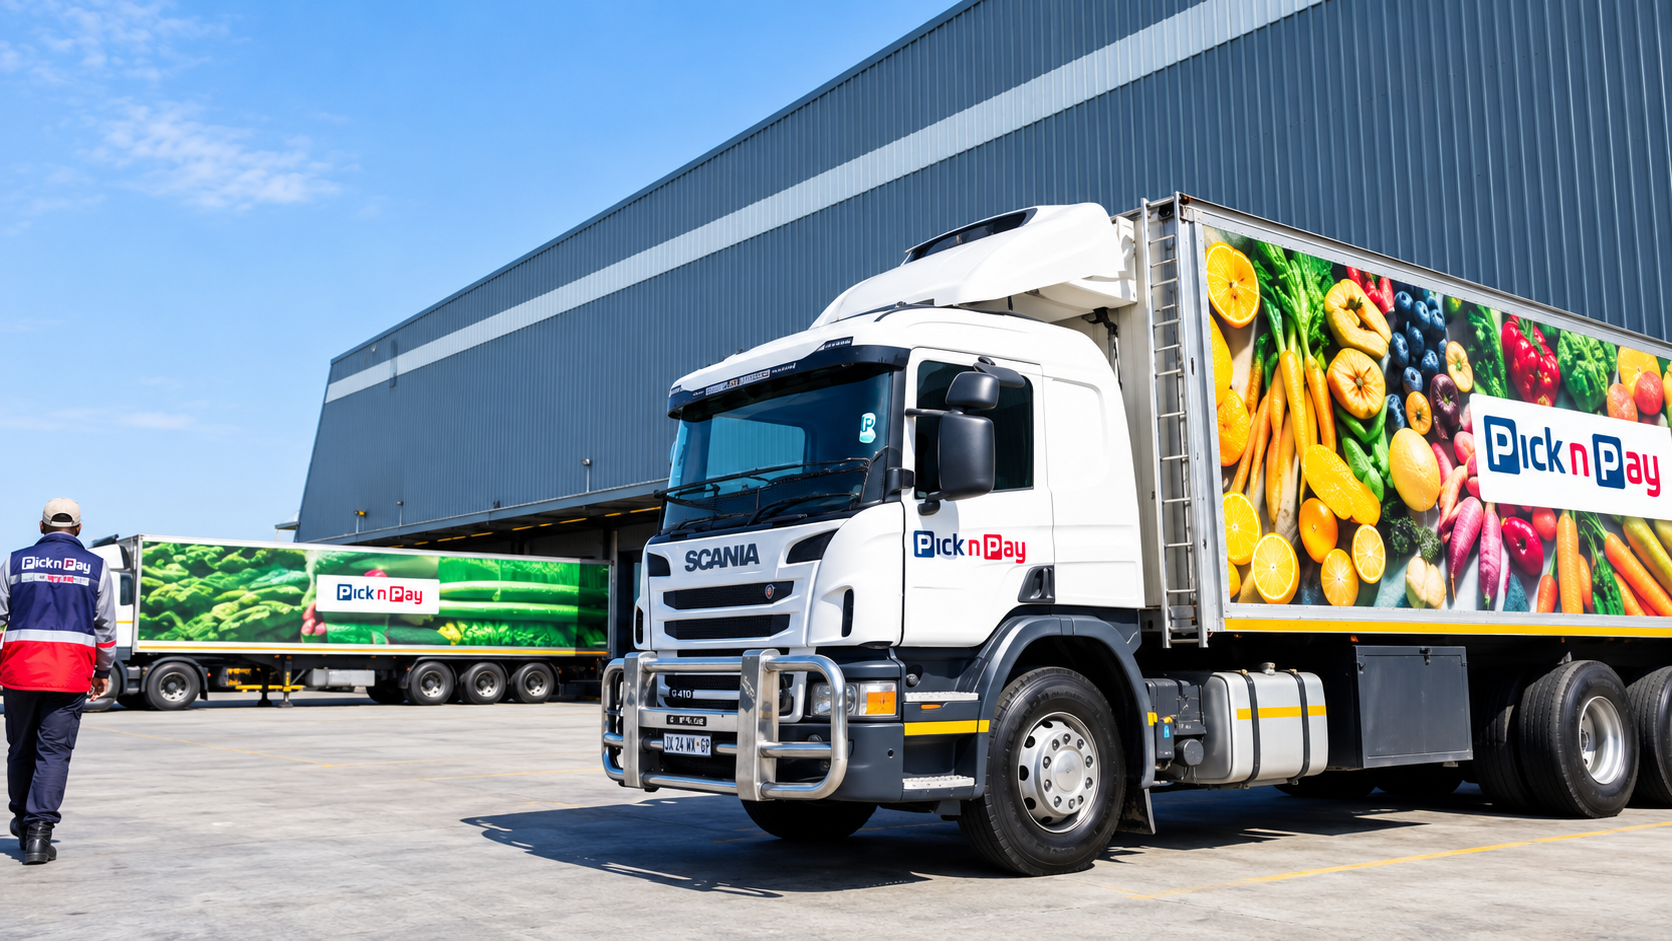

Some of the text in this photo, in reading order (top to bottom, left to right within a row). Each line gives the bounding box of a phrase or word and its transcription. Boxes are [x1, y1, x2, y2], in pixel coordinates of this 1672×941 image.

[1484, 415, 1661, 497] Pick n Pay
[685, 543, 760, 572] SCANIA
[914, 530, 1026, 564] Pick n Pay
[337, 584, 422, 605] Pick n Pay
[675, 736, 684, 752] 24
[701, 738, 710, 754] GP
